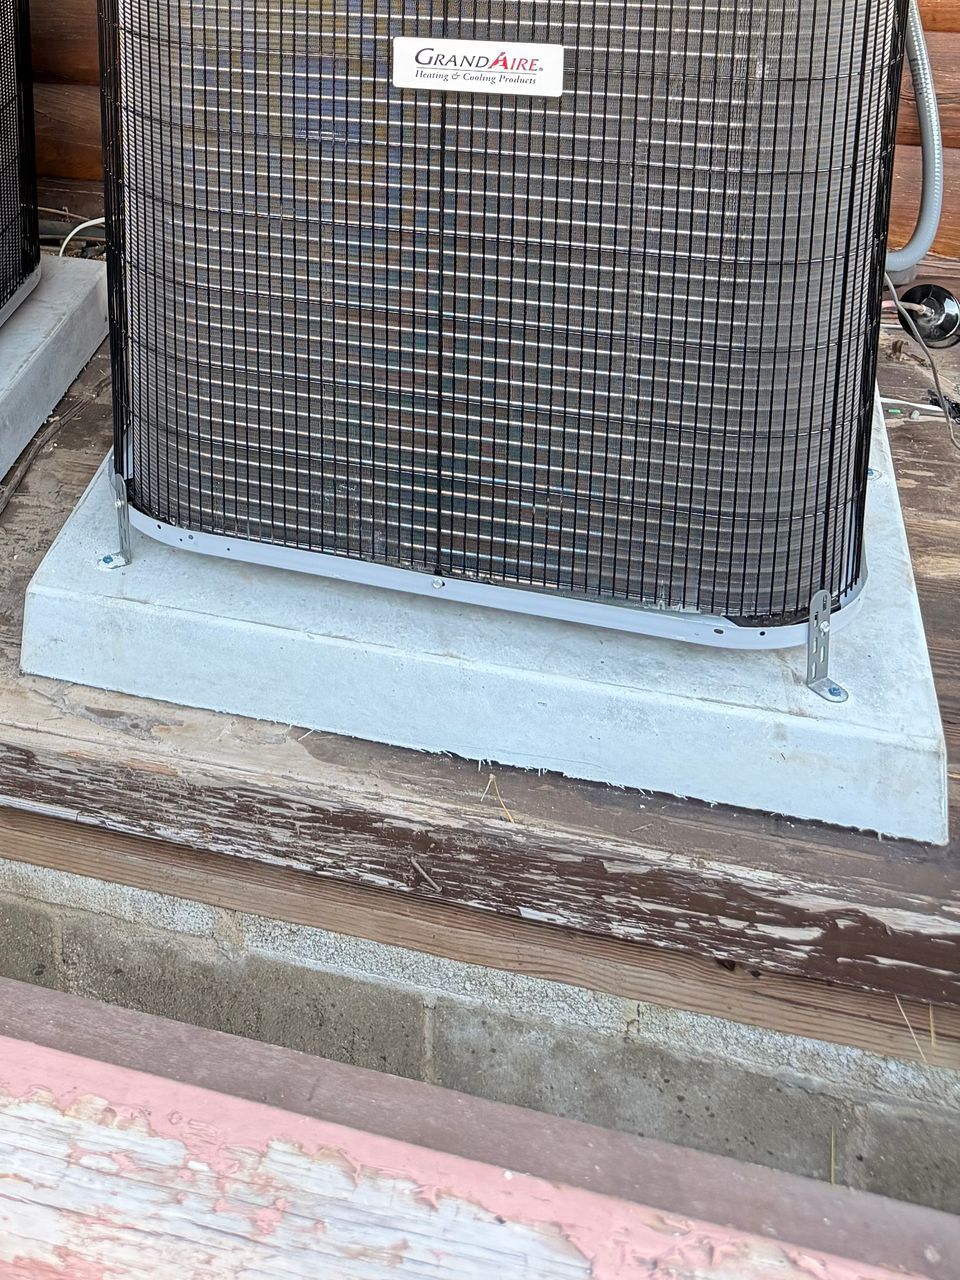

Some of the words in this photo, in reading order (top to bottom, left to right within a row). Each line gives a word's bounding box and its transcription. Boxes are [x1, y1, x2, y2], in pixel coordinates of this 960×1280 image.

[415, 70, 449, 82] Heating
[451, 72, 461, 80] &
[462, 73, 496, 84] Cooling
[498, 75, 537, 85] Products
